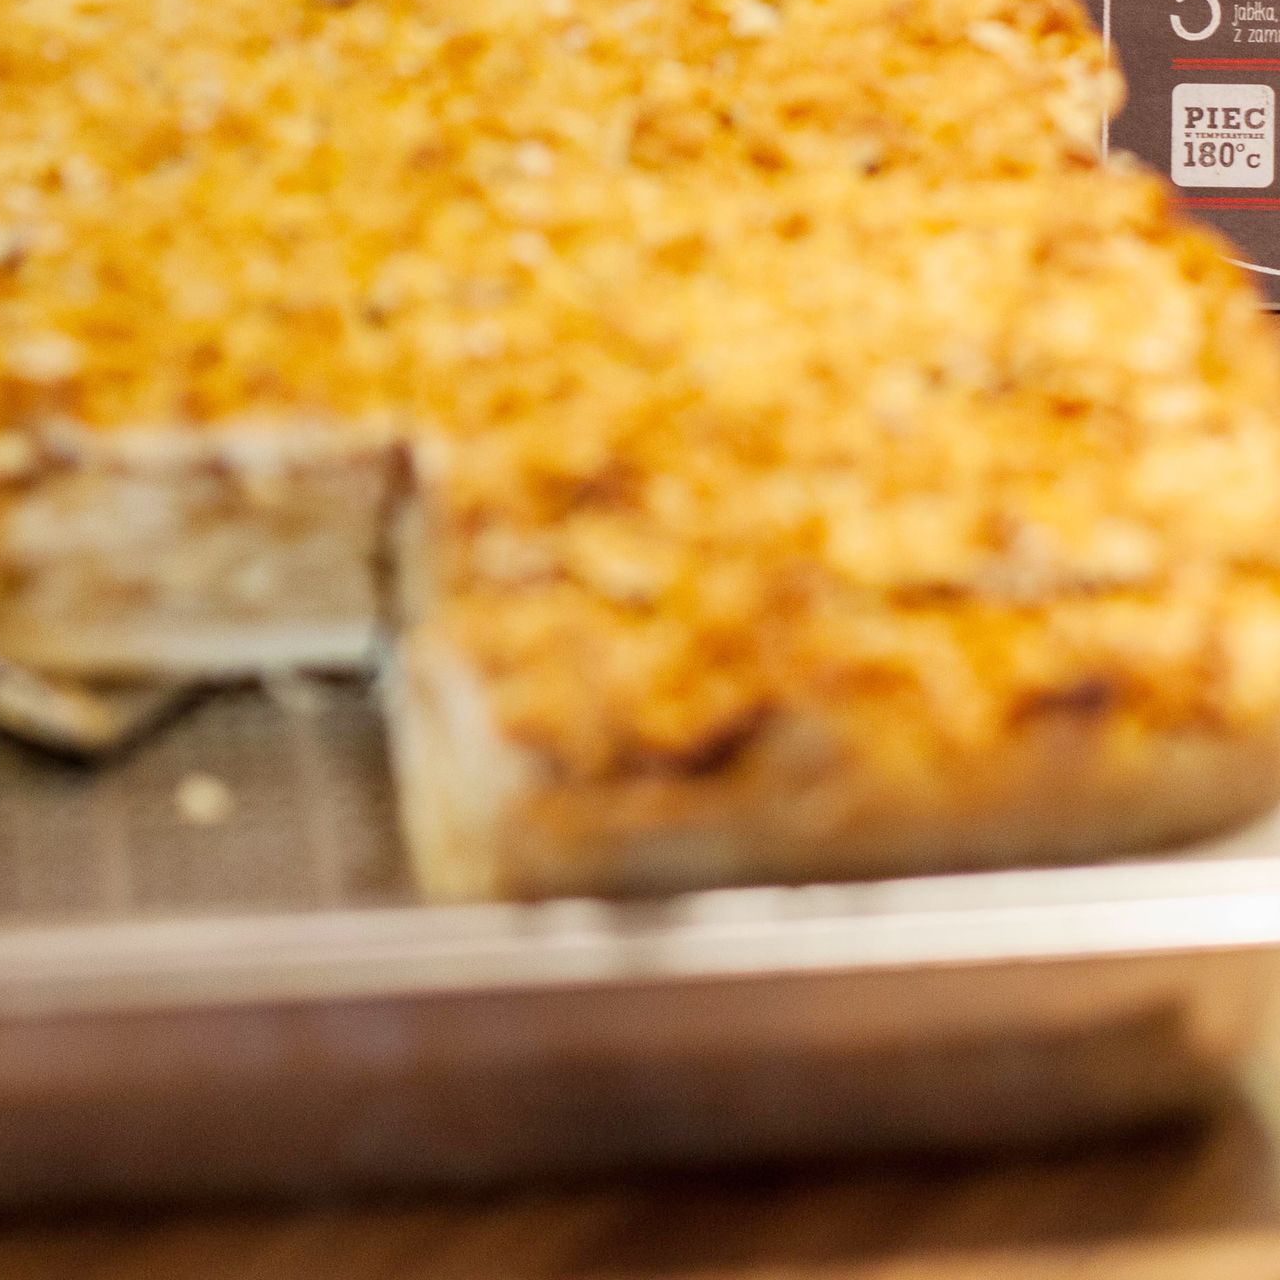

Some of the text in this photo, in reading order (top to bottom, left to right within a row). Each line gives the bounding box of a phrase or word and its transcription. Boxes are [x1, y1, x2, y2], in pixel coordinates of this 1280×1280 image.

[1231, 3, 1278, 26] jabłka,
[1233, 28, 1241, 43] z
[1184, 106, 1266, 130] PIEC
